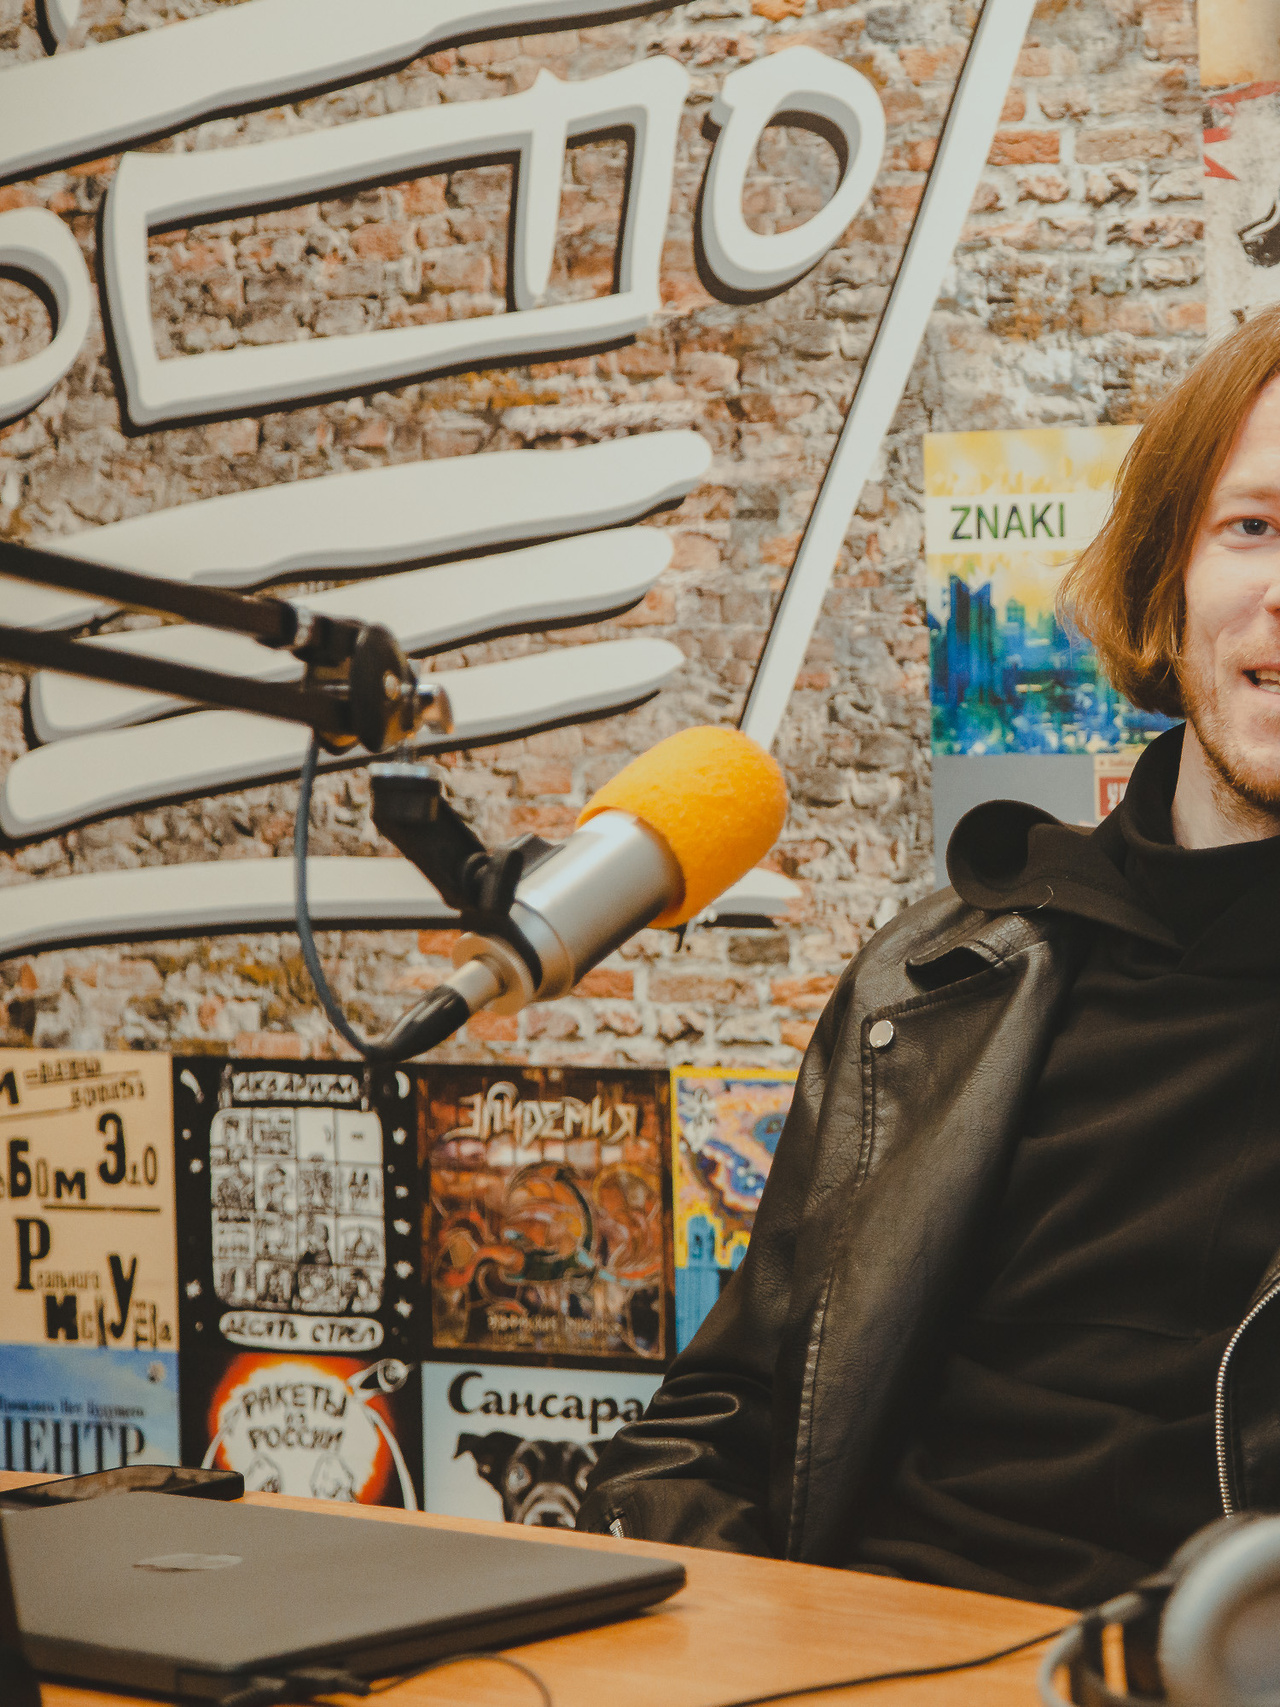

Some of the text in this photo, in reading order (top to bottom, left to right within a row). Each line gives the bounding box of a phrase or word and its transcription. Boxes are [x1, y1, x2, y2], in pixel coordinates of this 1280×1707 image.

[949, 502, 1067, 541] ZNAKI
[241, 1383, 348, 1419] РАКЕТЫ
[447, 1370, 645, 1435] Сансара
